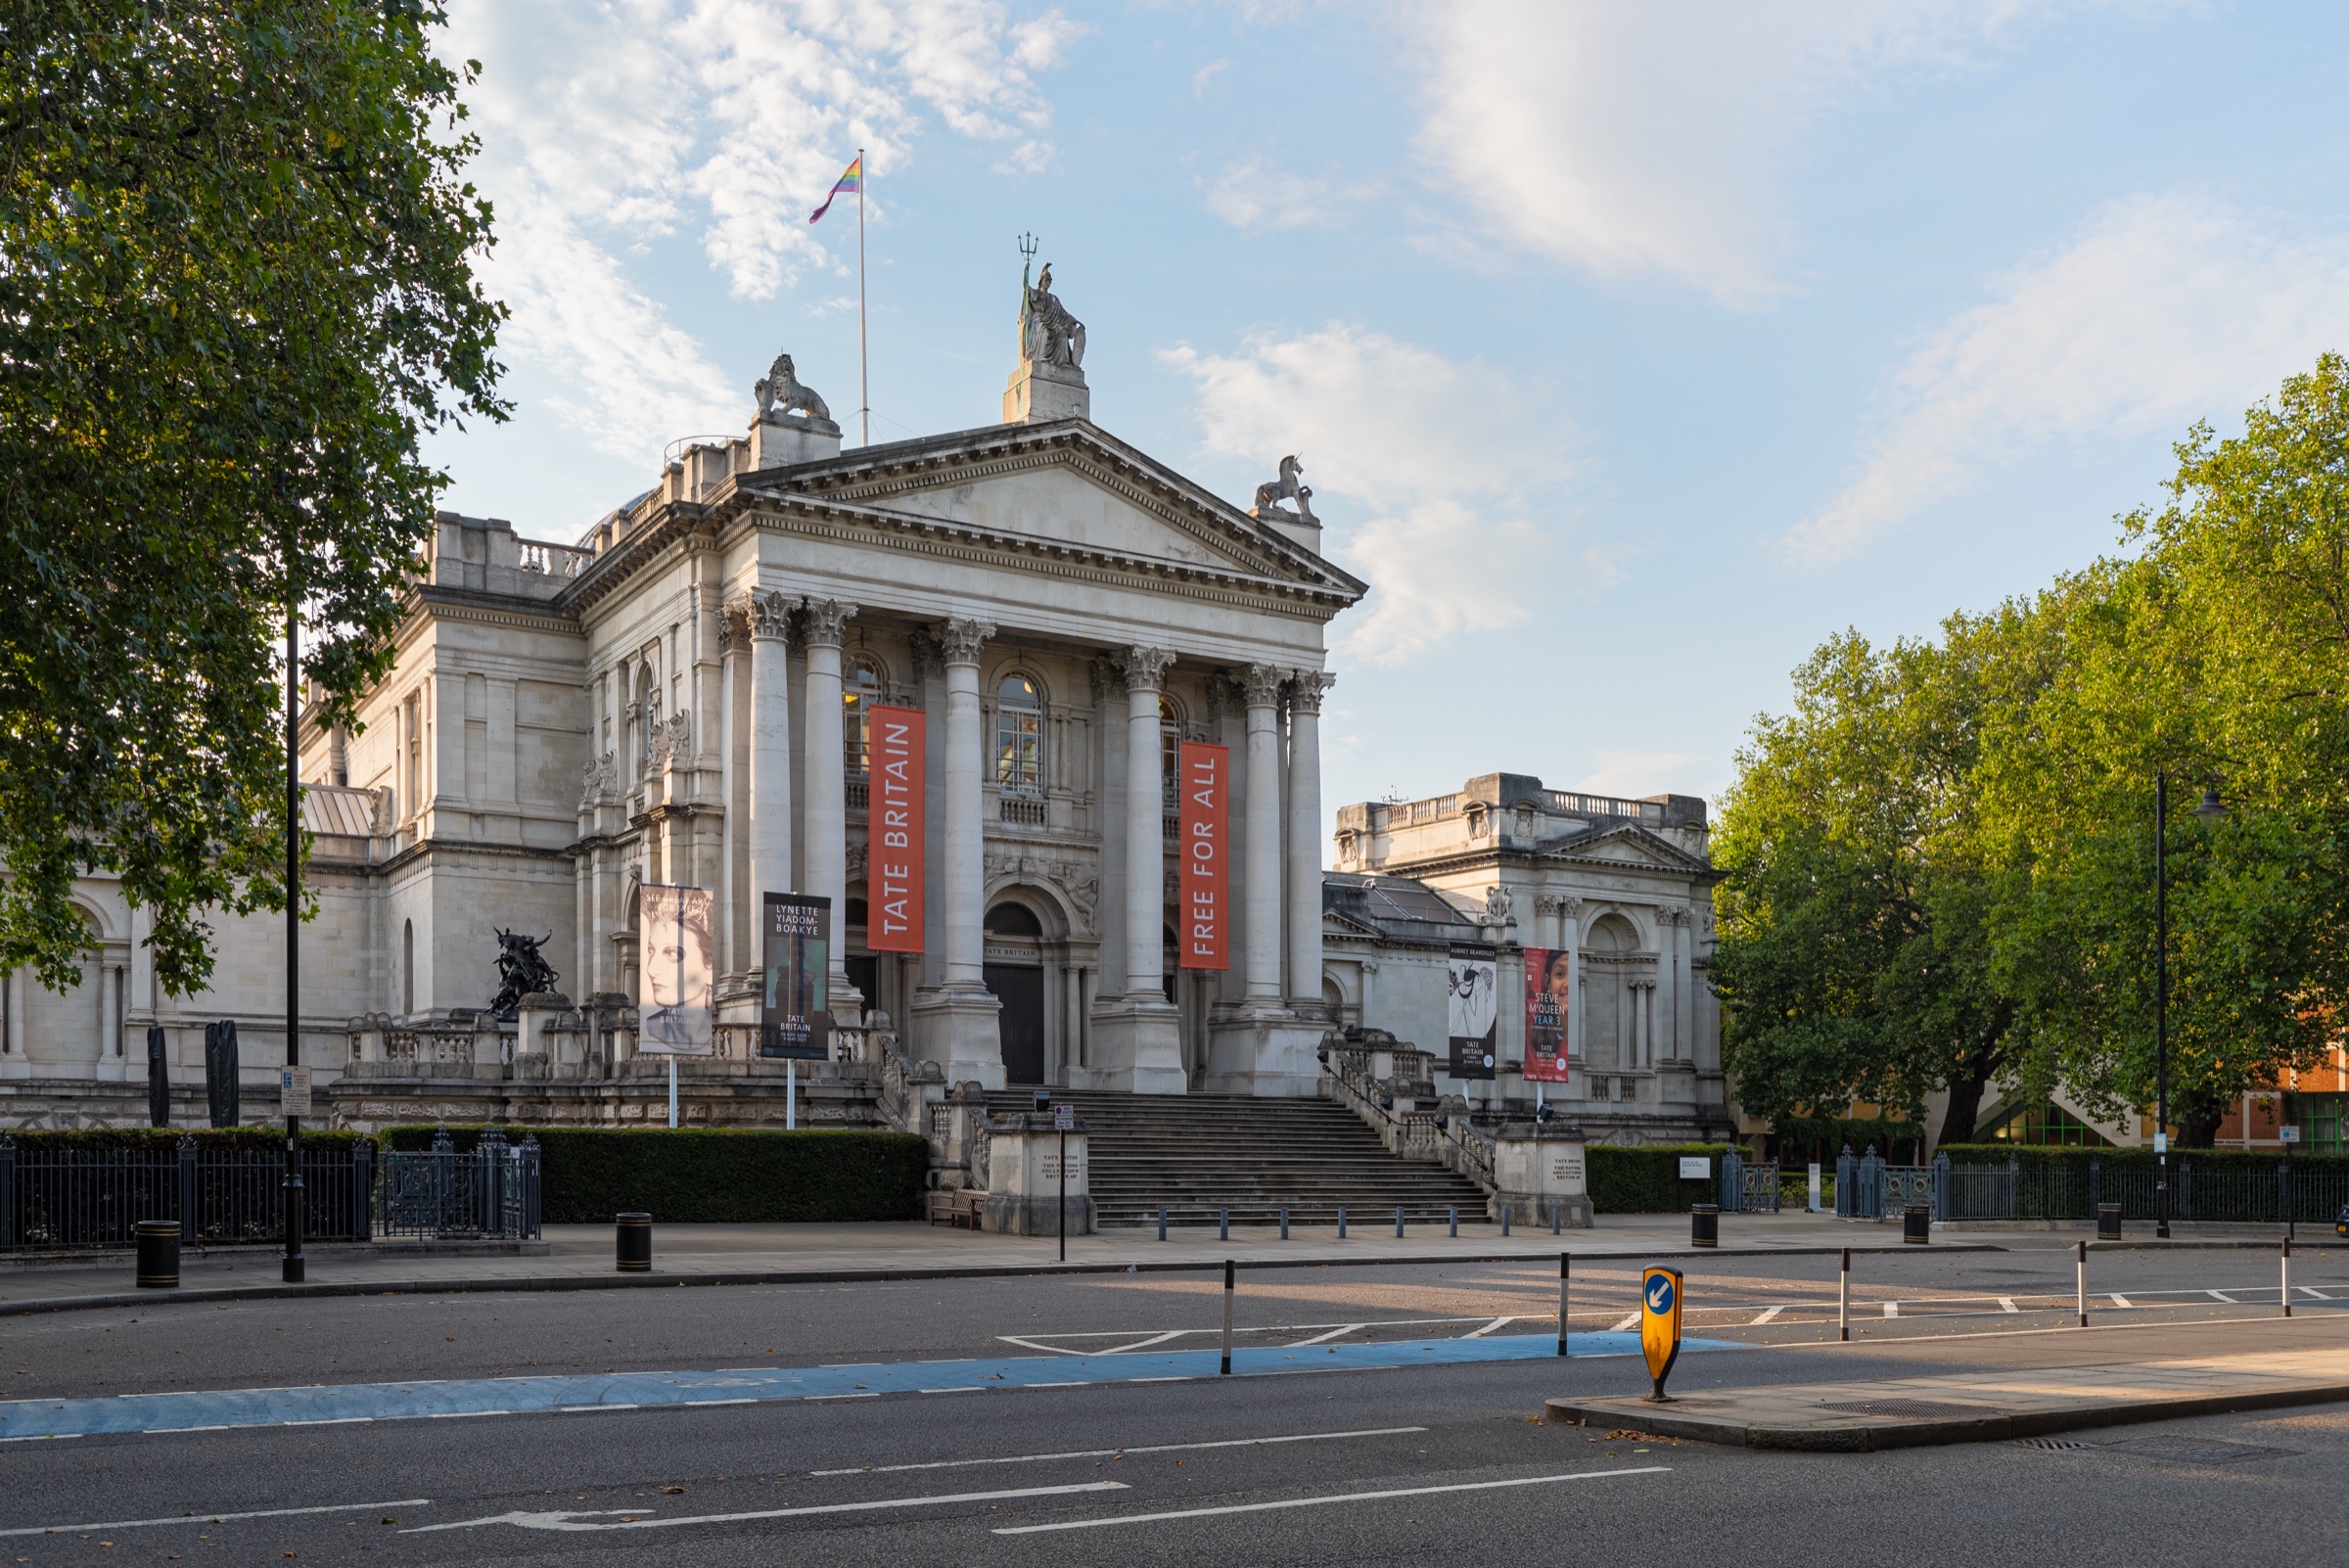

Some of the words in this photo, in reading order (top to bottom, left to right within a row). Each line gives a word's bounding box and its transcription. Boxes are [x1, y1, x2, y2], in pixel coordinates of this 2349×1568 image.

[884, 722, 909, 848] BRITAIN
[1193, 758, 1215, 808] ALL
[1193, 821, 1214, 876] FOR
[646, 893, 661, 902] SEE
[884, 863, 908, 935] TATE
[776, 904, 818, 916] LYNETTE
[776, 913, 818, 926] YIADOM-
[1193, 891, 1215, 955] FREE
[776, 923, 818, 936] BOAKYE
[1469, 948, 1496, 957] BEARDSLEY
[1535, 992, 1559, 1003] STEVE
[667, 1007, 685, 1016] TATE
[660, 1015, 693, 1025] BRITAIN
[787, 1014, 805, 1023] TATE
[1533, 1014, 1553, 1026] YEAR
[1555, 1016, 1561, 1026] 3
[780, 1022, 811, 1032] BRITAIN
